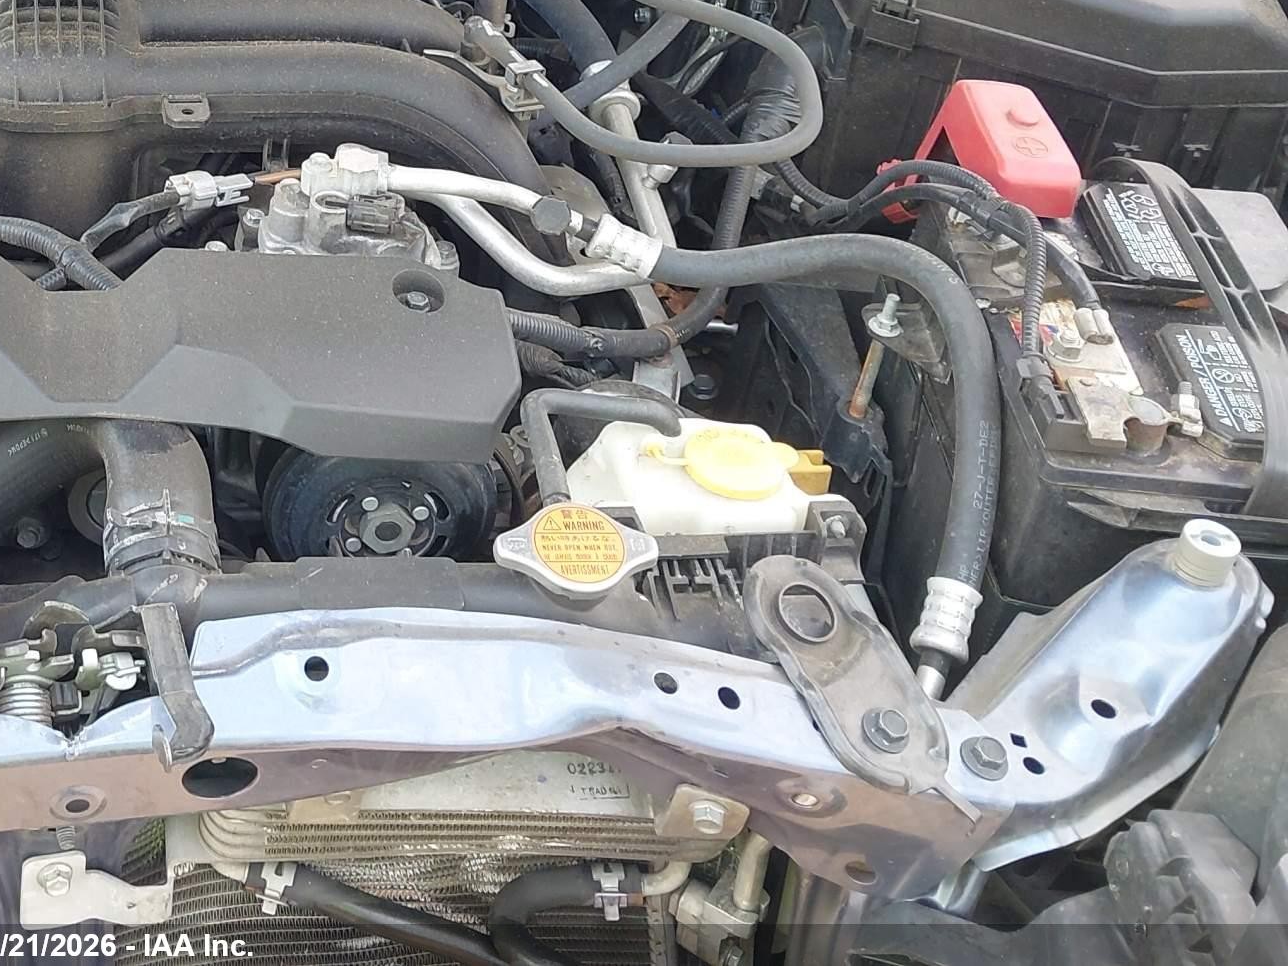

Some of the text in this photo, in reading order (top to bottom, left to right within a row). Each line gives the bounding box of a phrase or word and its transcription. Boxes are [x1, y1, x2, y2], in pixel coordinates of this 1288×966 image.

[1176, 335, 1203, 369] POISON
[1199, 378, 1229, 417] DANGER
[563, 521, 605, 531] WARNING
